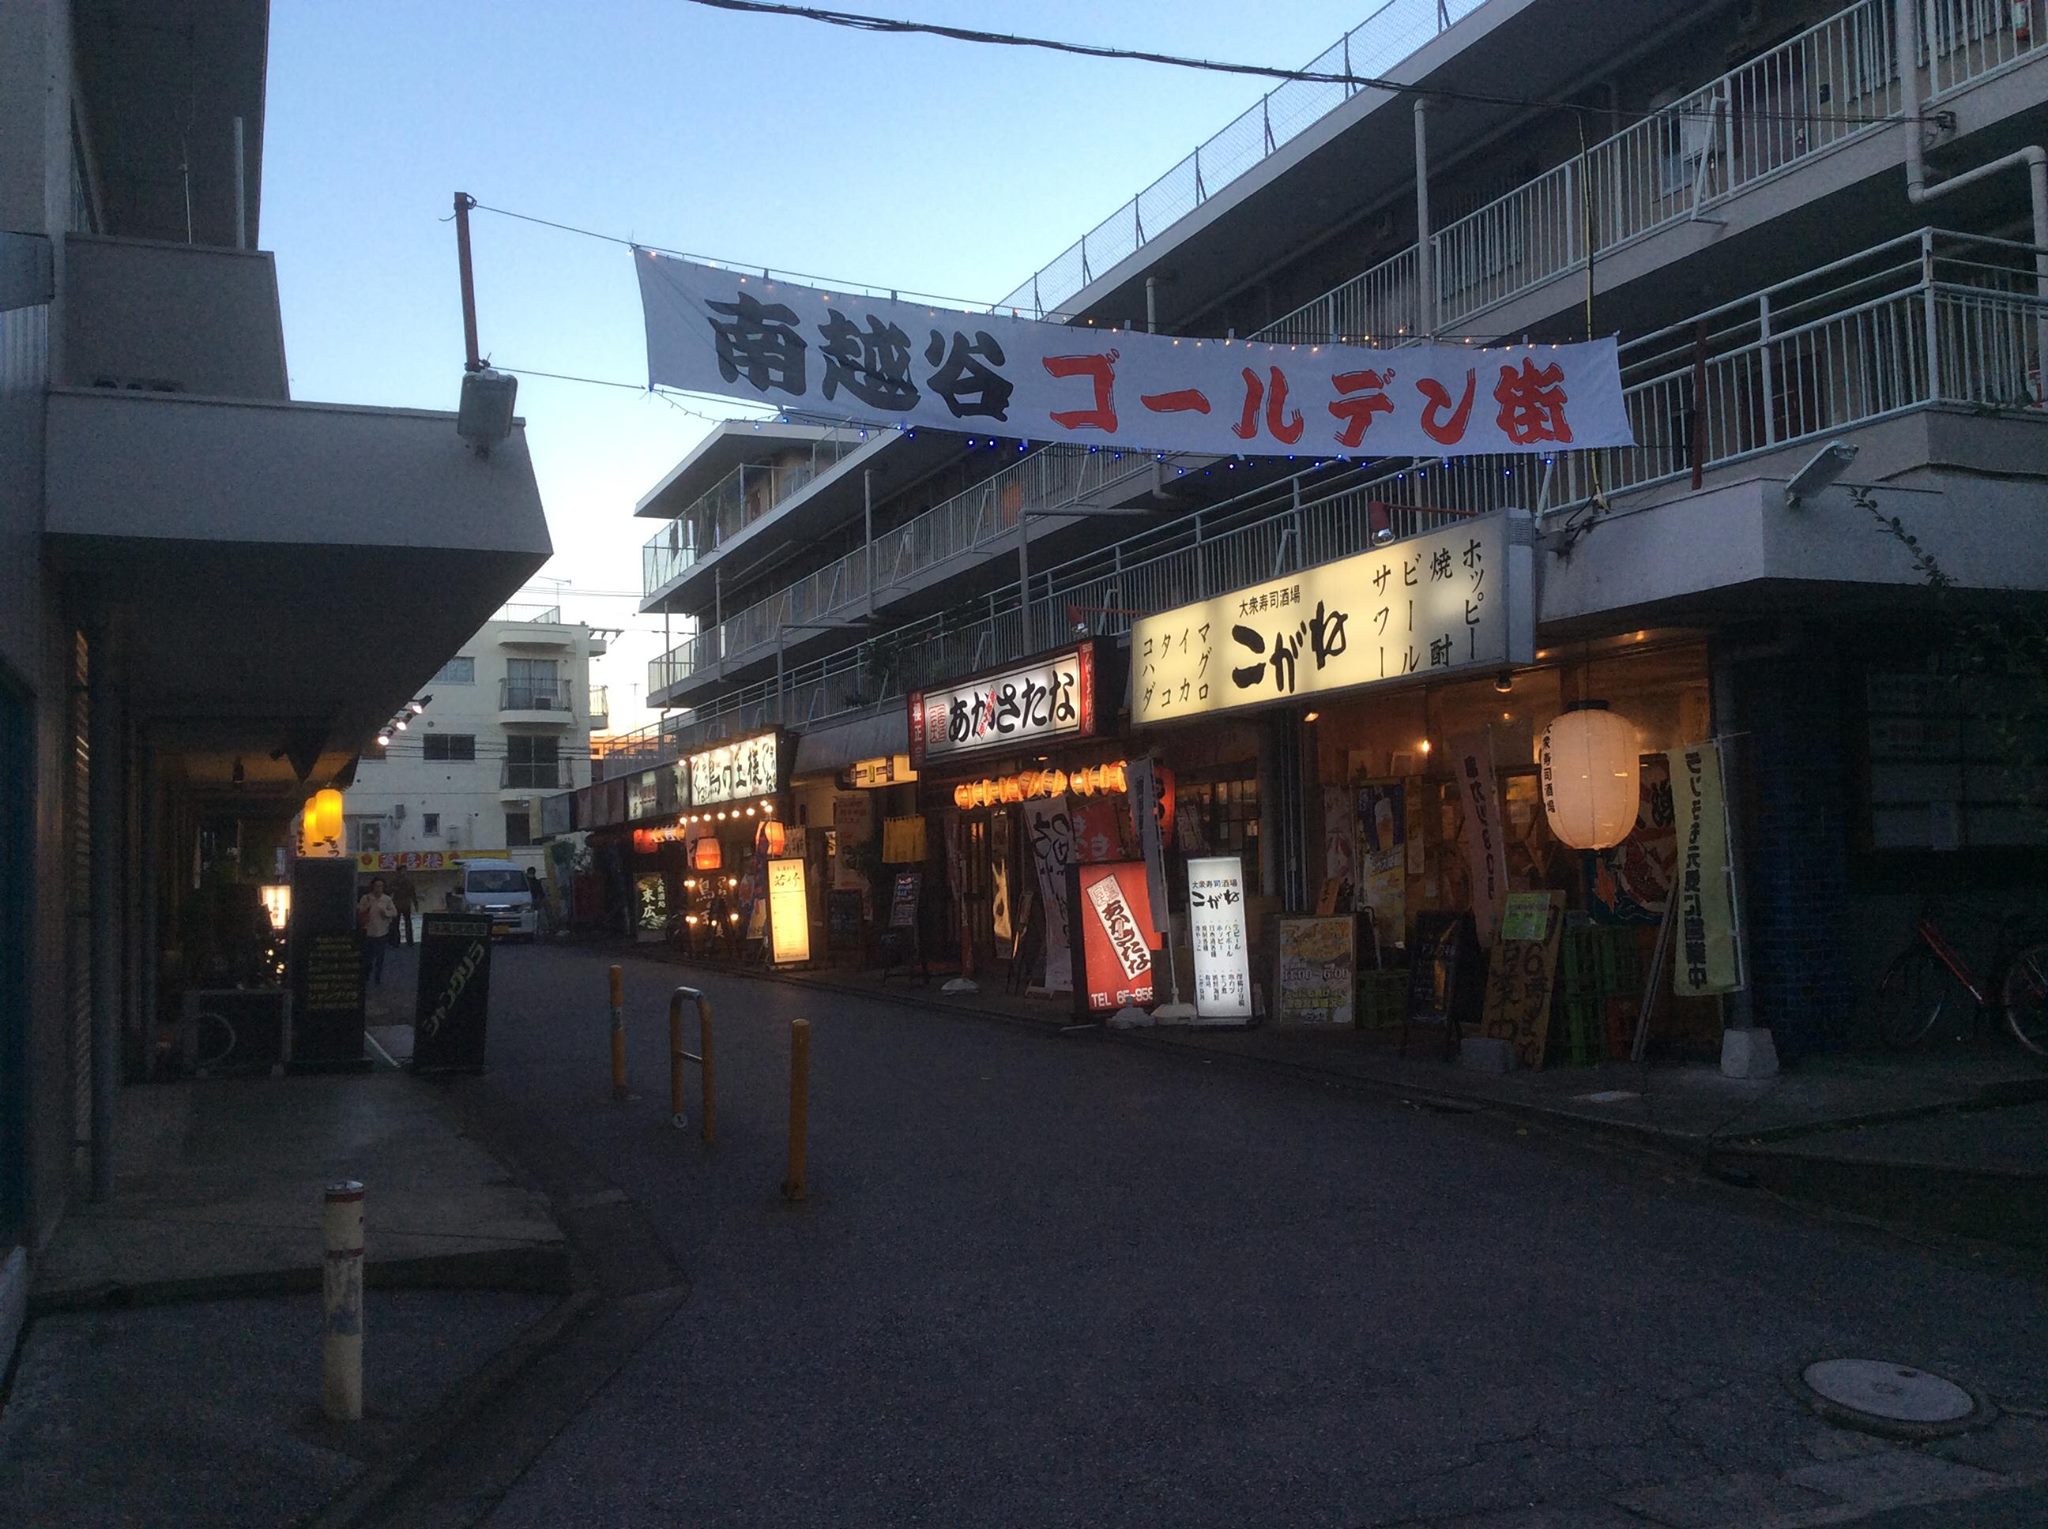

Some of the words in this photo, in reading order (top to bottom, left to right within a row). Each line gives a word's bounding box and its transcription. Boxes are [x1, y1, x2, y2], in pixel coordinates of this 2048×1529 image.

[705, 292, 1573, 448] 南越谷ゴールデン街
[1239, 584, 1301, 618] 大衆寿司酒場
[1372, 564, 1391, 678] サワー
[1400, 554, 1421, 674] ビール
[1430, 551, 1453, 667] 焼酎
[1462, 539, 1486, 660] ホッピー
[1142, 639, 1157, 713] コハダ
[1160, 634, 1173, 708] タコ
[1178, 627, 1190, 702] イカ
[1198, 621, 1210, 701] マグロ
[1231, 601, 1349, 694] こがね
[949, 670, 1076, 742] あかさたな
[1192, 889, 1240, 909] こがね
[1091, 992, 1112, 1007] TEL
